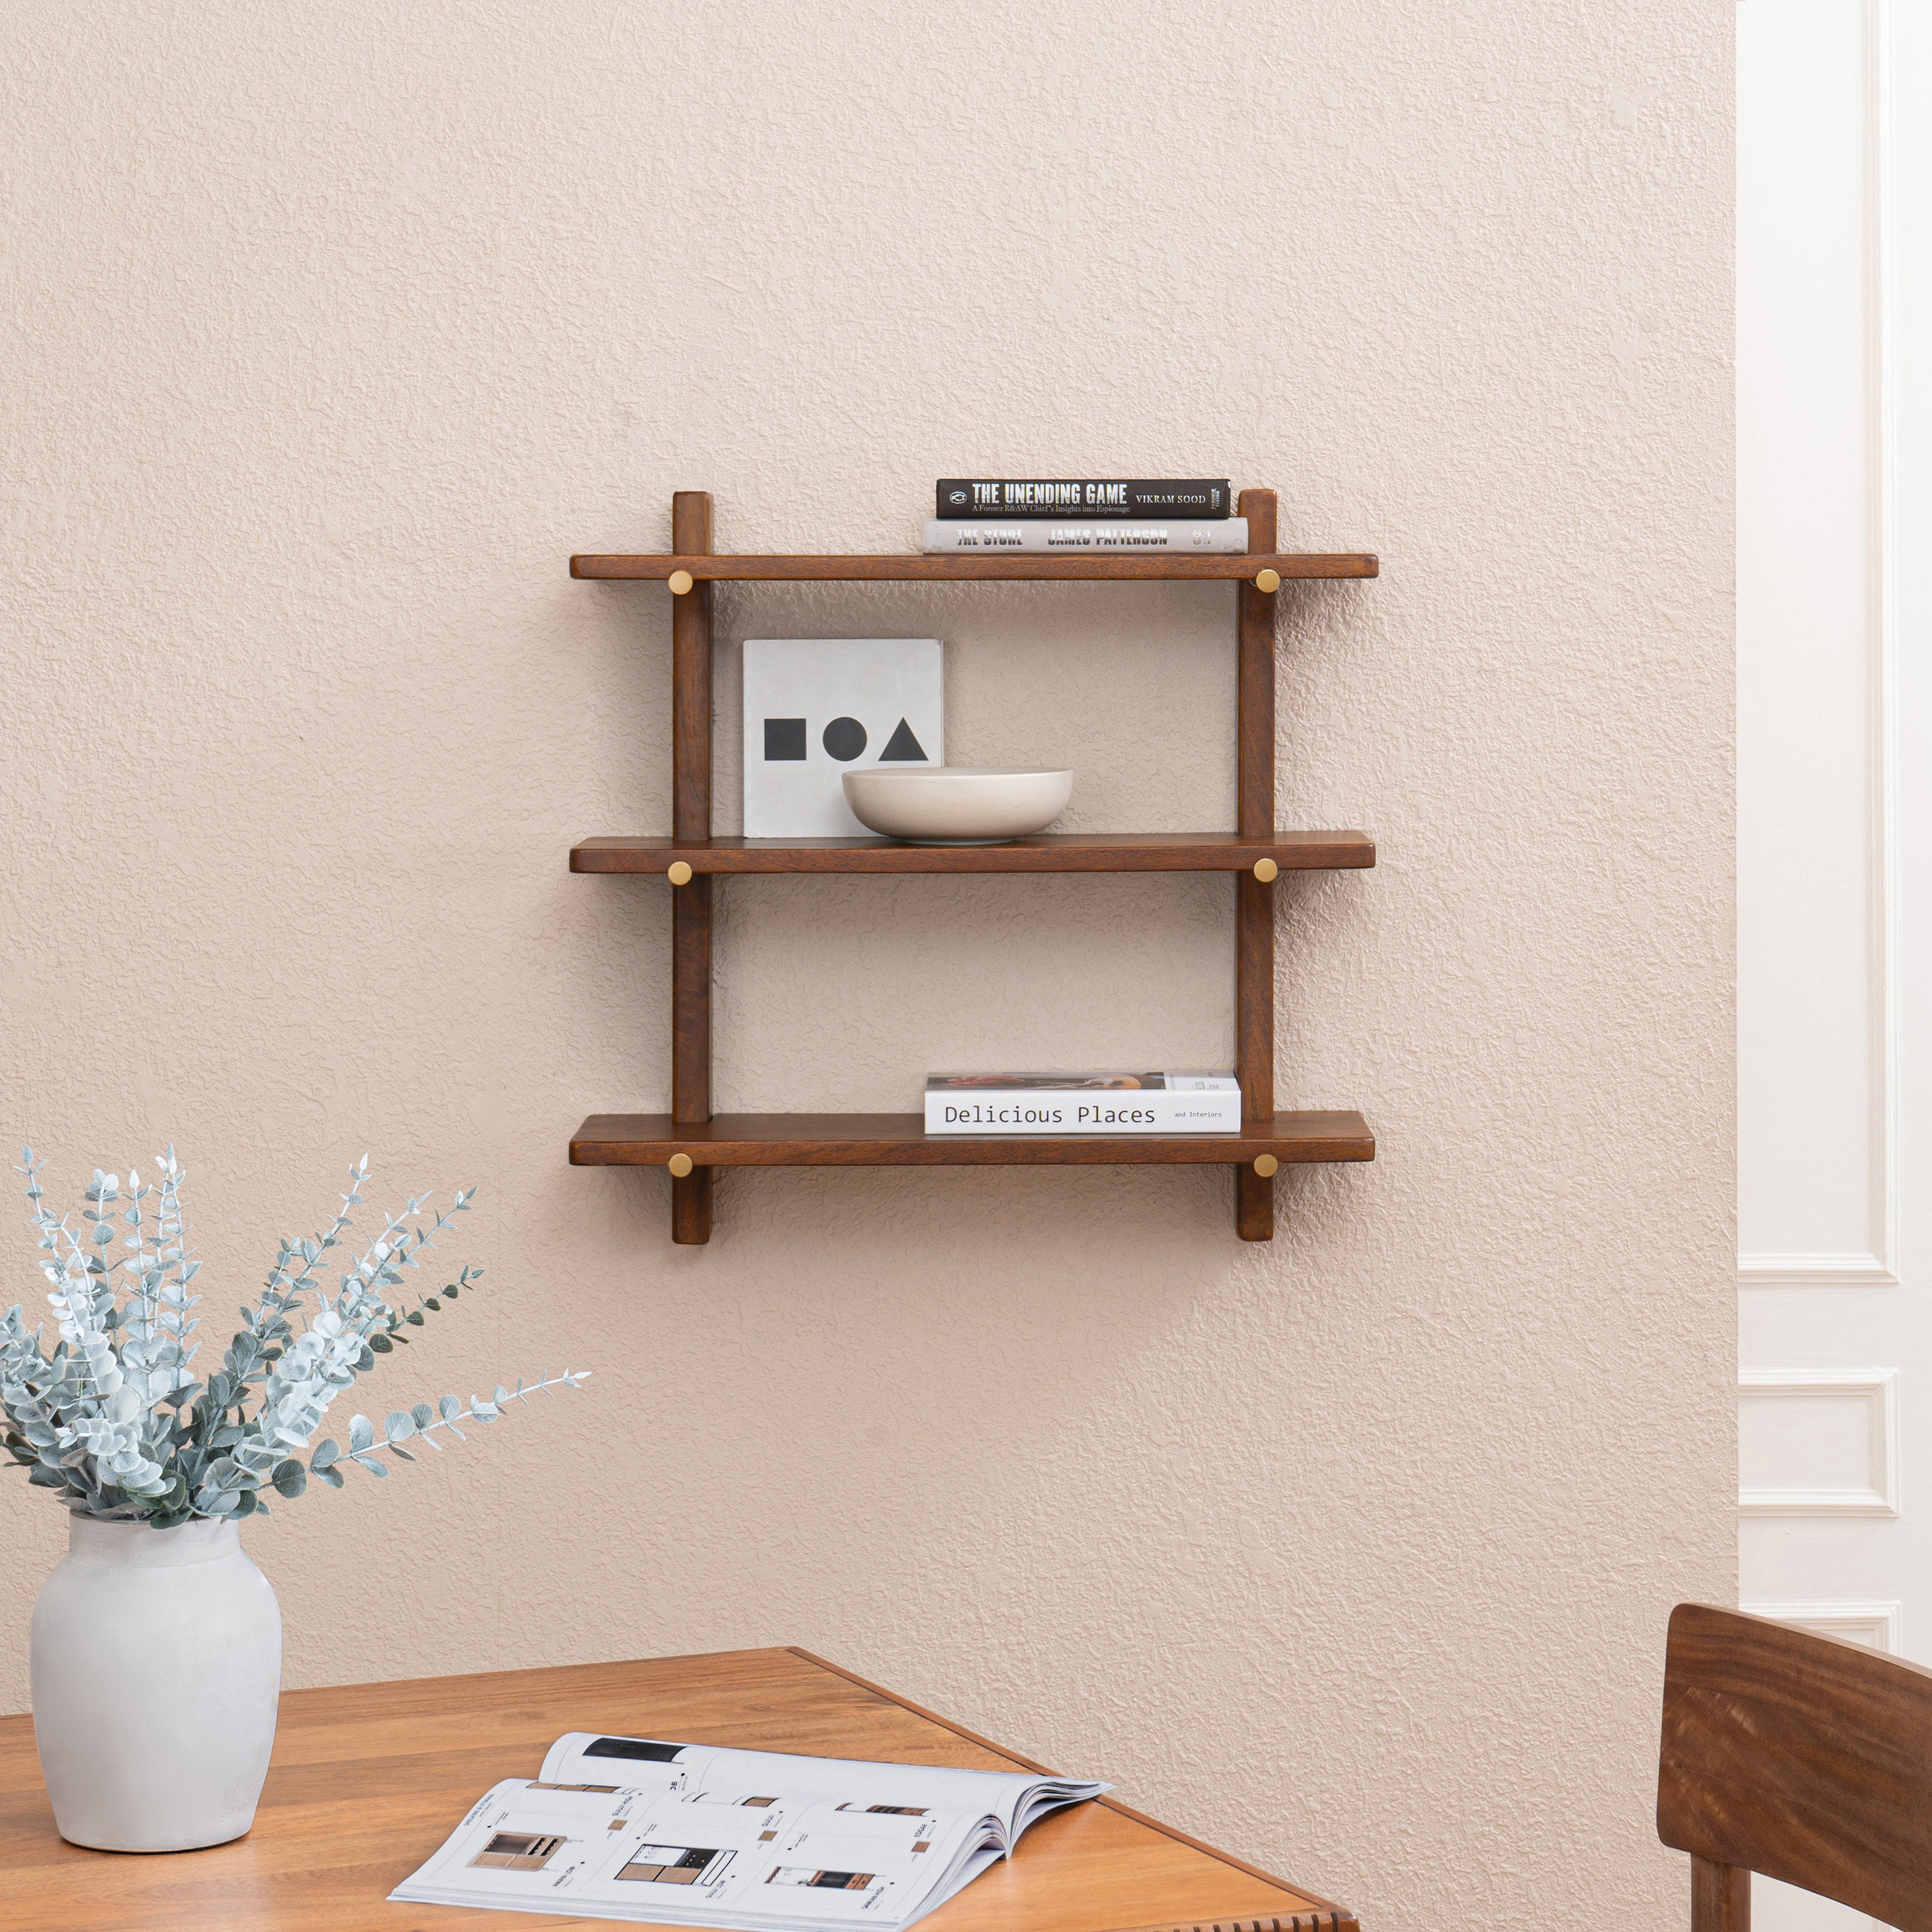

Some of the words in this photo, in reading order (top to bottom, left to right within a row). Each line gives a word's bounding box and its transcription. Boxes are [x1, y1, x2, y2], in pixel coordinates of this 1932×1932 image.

[972, 483, 1000, 504] THE
[1005, 483, 1080, 504] UNENDING
[1086, 483, 1127, 504] GAME
[1177, 495, 1206, 503] SOOD
[1055, 505, 1081, 514] Insights
[1096, 505, 1130, 514] Espionage
[956, 529, 978, 545] THE
[1048, 529, 1091, 545] JAMES
[1096, 528, 1168, 545] PATTERSON
[945, 1106, 1063, 1123] Delicious
[1079, 1106, 1155, 1123] Places
